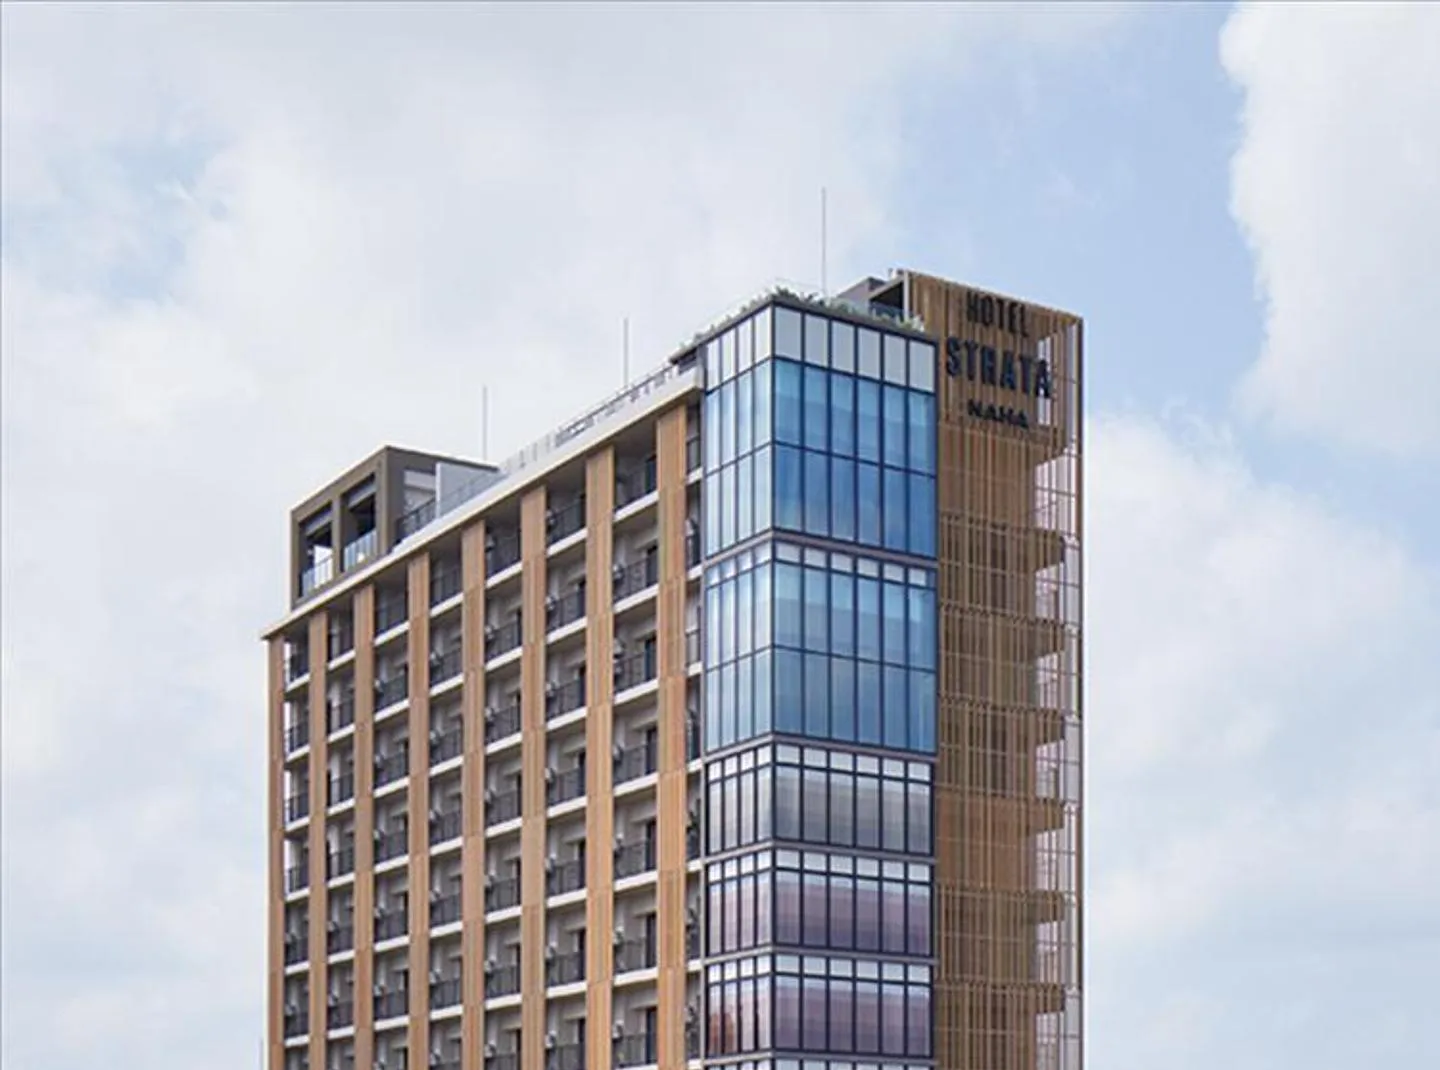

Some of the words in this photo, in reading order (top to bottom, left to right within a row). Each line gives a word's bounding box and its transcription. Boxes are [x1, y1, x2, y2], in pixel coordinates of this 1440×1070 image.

[966, 289, 1028, 338] HOTEL
[945, 336, 1051, 398] STRATA
[967, 400, 1029, 429] NAHA
